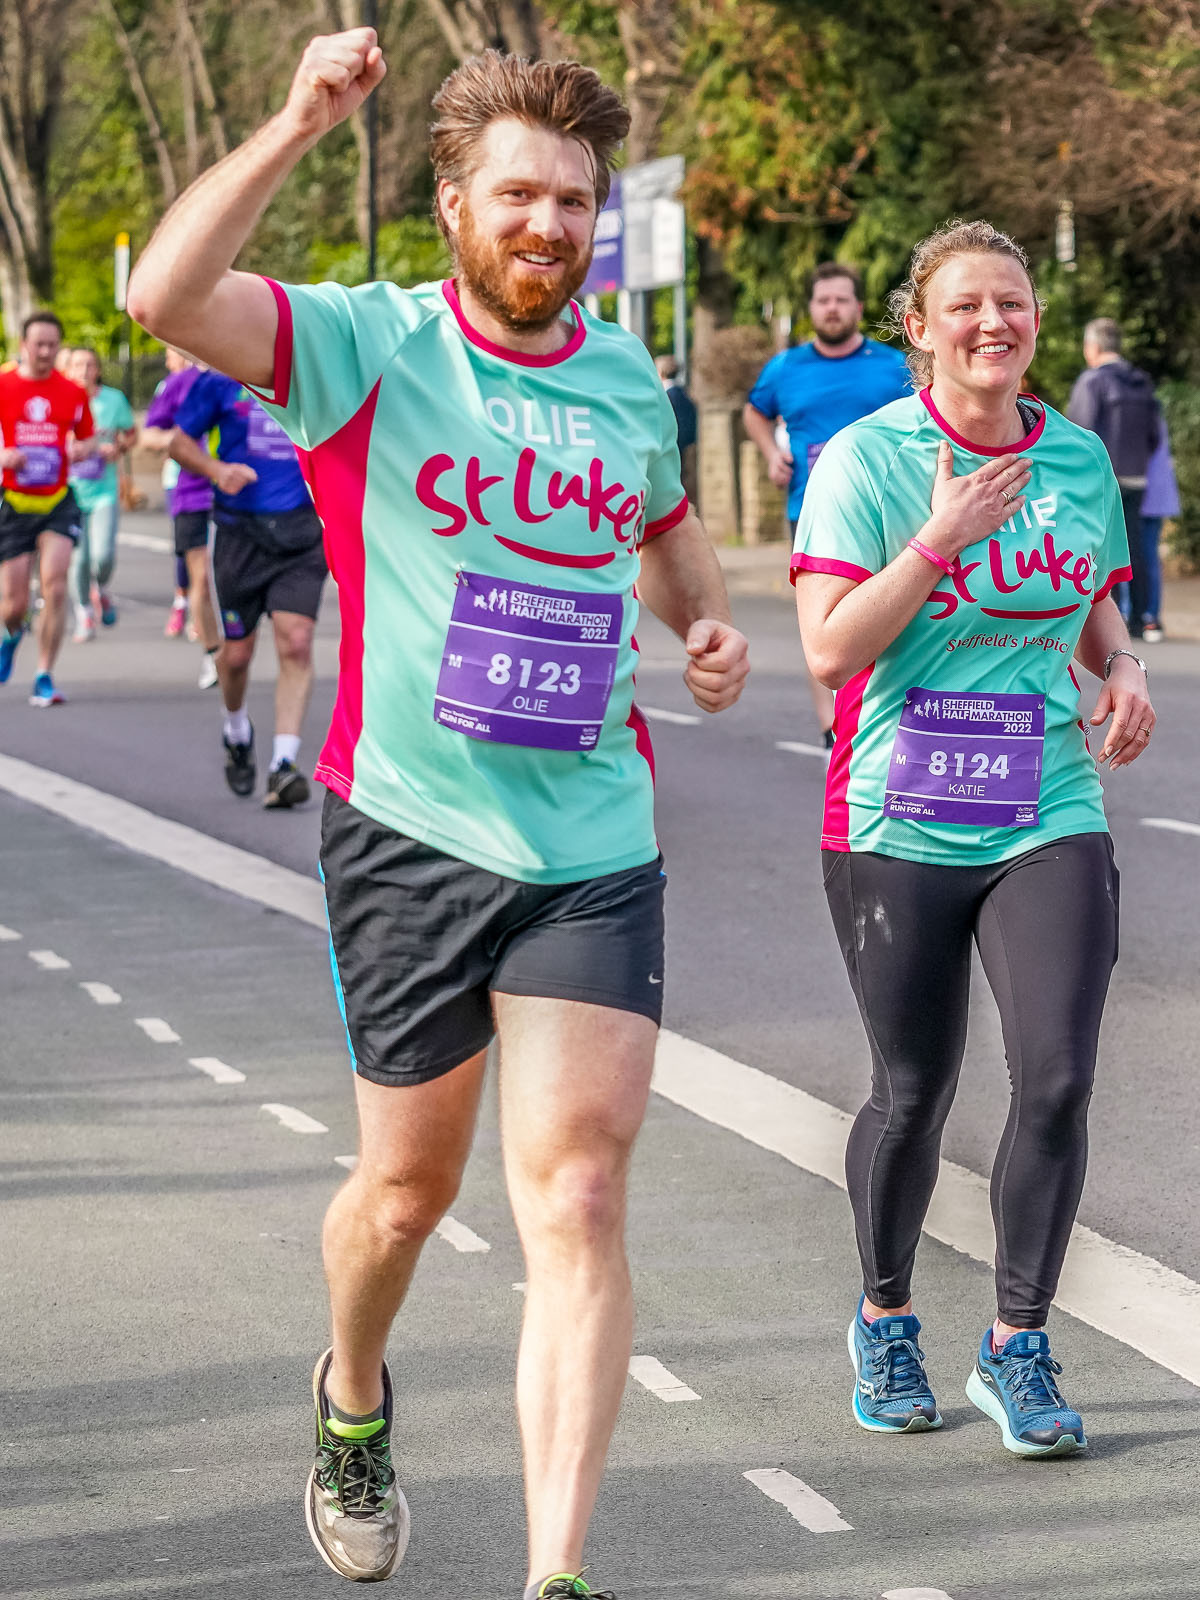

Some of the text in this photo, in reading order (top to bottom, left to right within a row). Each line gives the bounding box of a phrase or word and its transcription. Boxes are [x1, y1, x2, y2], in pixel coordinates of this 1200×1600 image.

[485, 397, 596, 447] OLIE
[415, 453, 504, 537] St
[513, 592, 573, 611] SHEFFIELD
[510, 604, 610, 626] HALF MARATHON
[580, 627, 609, 640] 2022
[448, 653, 463, 669] M
[486, 653, 582, 695] 8123
[512, 696, 549, 713] OLIE
[943, 699, 993, 710] SHEFFIELD
[439, 711, 458, 724] RUN
[457, 717, 475, 729] FOR
[474, 722, 491, 733] ALL
[942, 710, 1031, 722] HALF MARATHON
[1003, 723, 1032, 734] 2022
[895, 753, 907, 766] M
[928, 750, 1010, 780] 8124
[948, 783, 986, 797] KATIE
[890, 804, 936, 816] RUN FOR ALL
